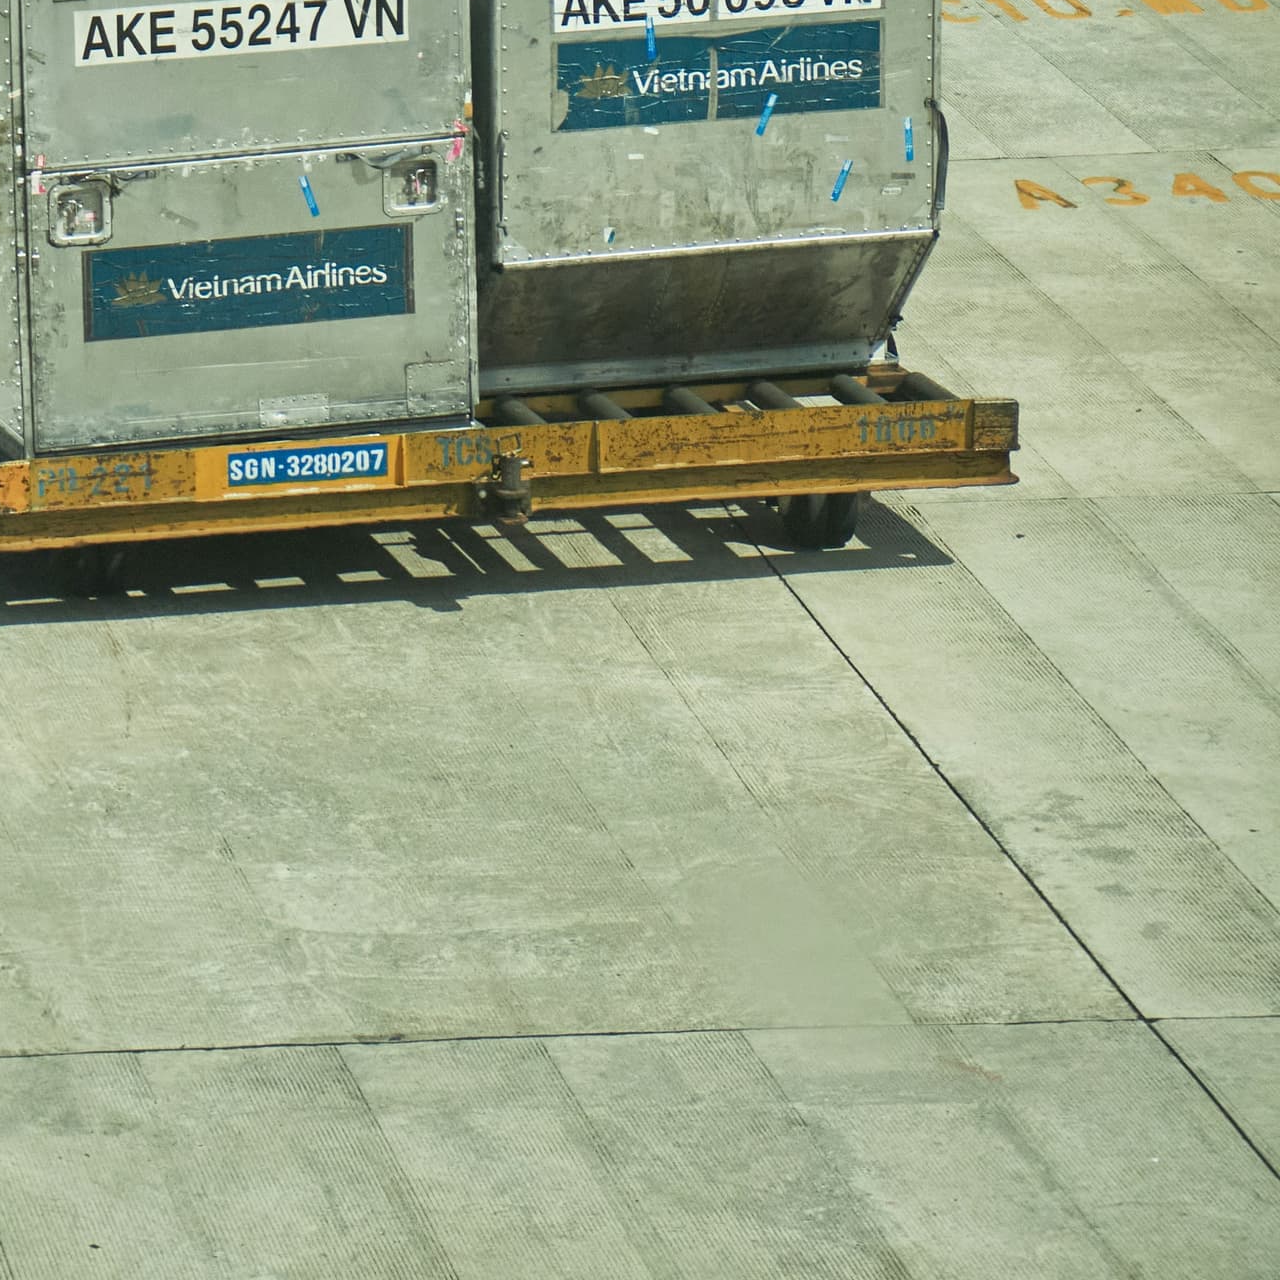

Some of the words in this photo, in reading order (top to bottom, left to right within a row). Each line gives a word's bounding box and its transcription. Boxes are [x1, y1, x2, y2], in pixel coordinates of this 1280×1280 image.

[82, 10, 176, 60] AKE
[192, 0, 327, 50] 55247
[633, 66, 757, 94] Vietnam
[759, 55, 863, 86] Airlines
[167, 271, 282, 300] Vietnam
[285, 262, 387, 289] Airlines
[230, 449, 384, 481] SGN-3280207
